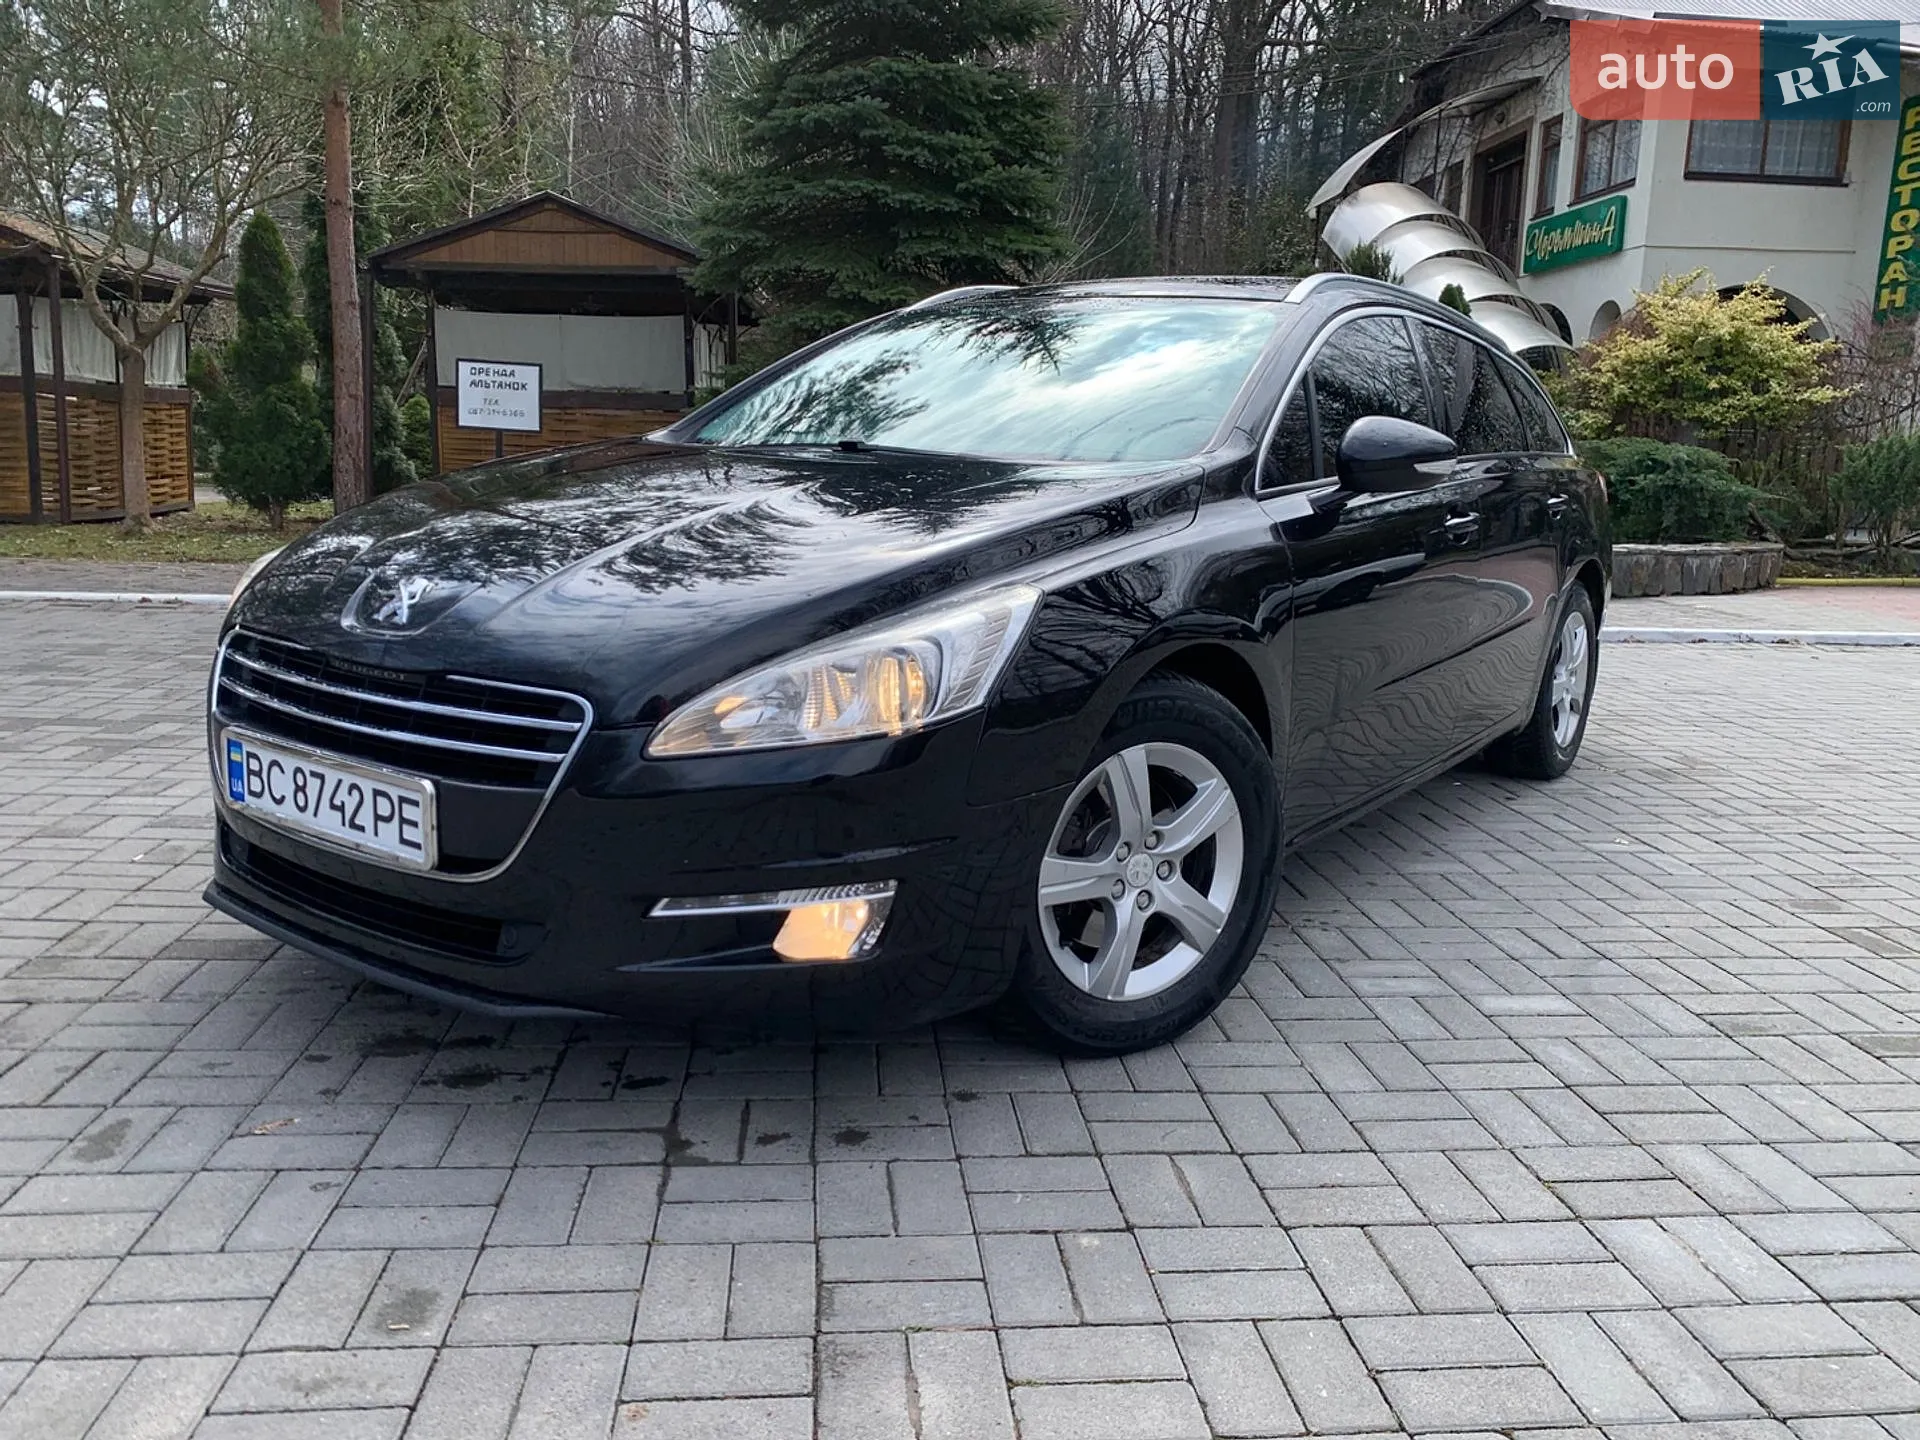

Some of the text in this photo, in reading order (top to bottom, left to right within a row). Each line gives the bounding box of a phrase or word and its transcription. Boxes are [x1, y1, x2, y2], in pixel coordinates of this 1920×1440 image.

[1878, 106, 1920, 311] РЕСТОРАН
[470, 367, 515, 377] ОРЕНДА
[469, 379, 528, 390] АЛЬТАНОК
[231, 776, 245, 794] UA
